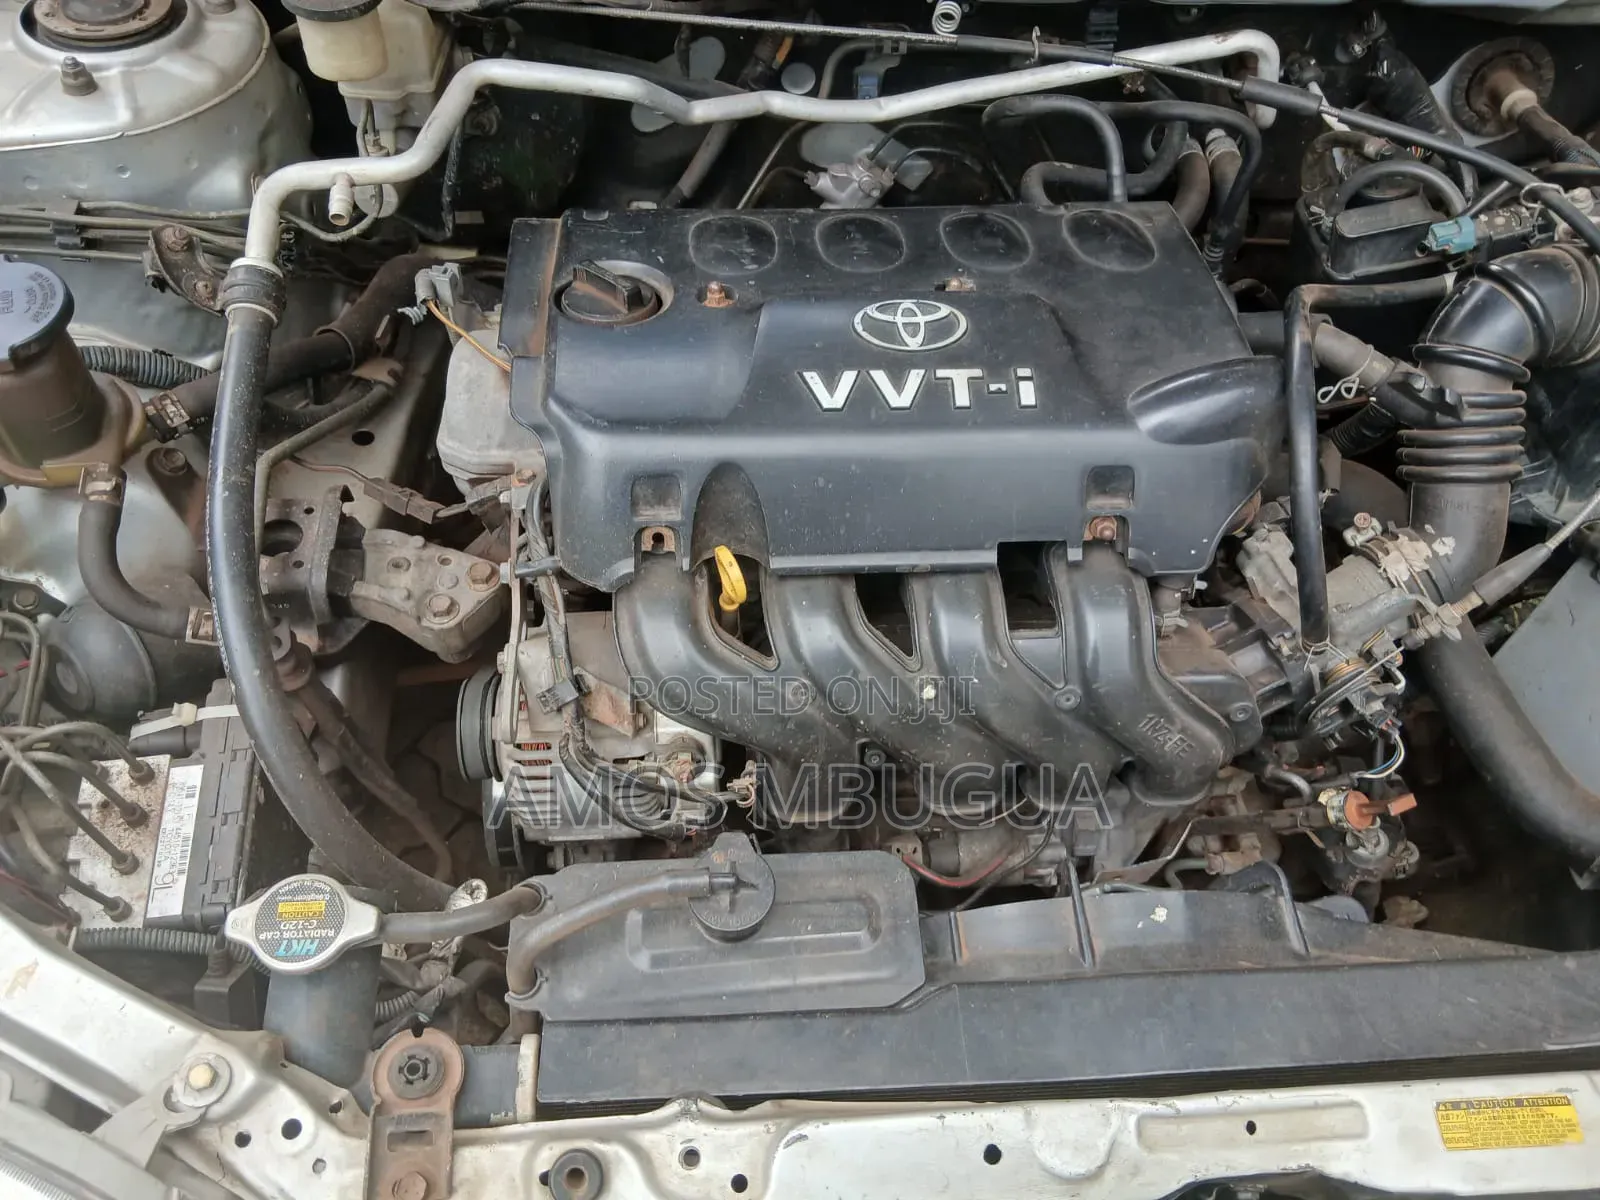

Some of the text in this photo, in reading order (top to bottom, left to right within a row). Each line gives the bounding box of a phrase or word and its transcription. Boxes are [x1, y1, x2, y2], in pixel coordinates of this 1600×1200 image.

[797, 368, 1037, 412] VVT-i
[282, 911, 321, 919] CAUTION
[259, 928, 335, 940] RADIATOR CAP
[275, 939, 319, 957] HKT
[1474, 1099, 1517, 1109] CAUTION
[1523, 1096, 1569, 1107] ATTENTION
